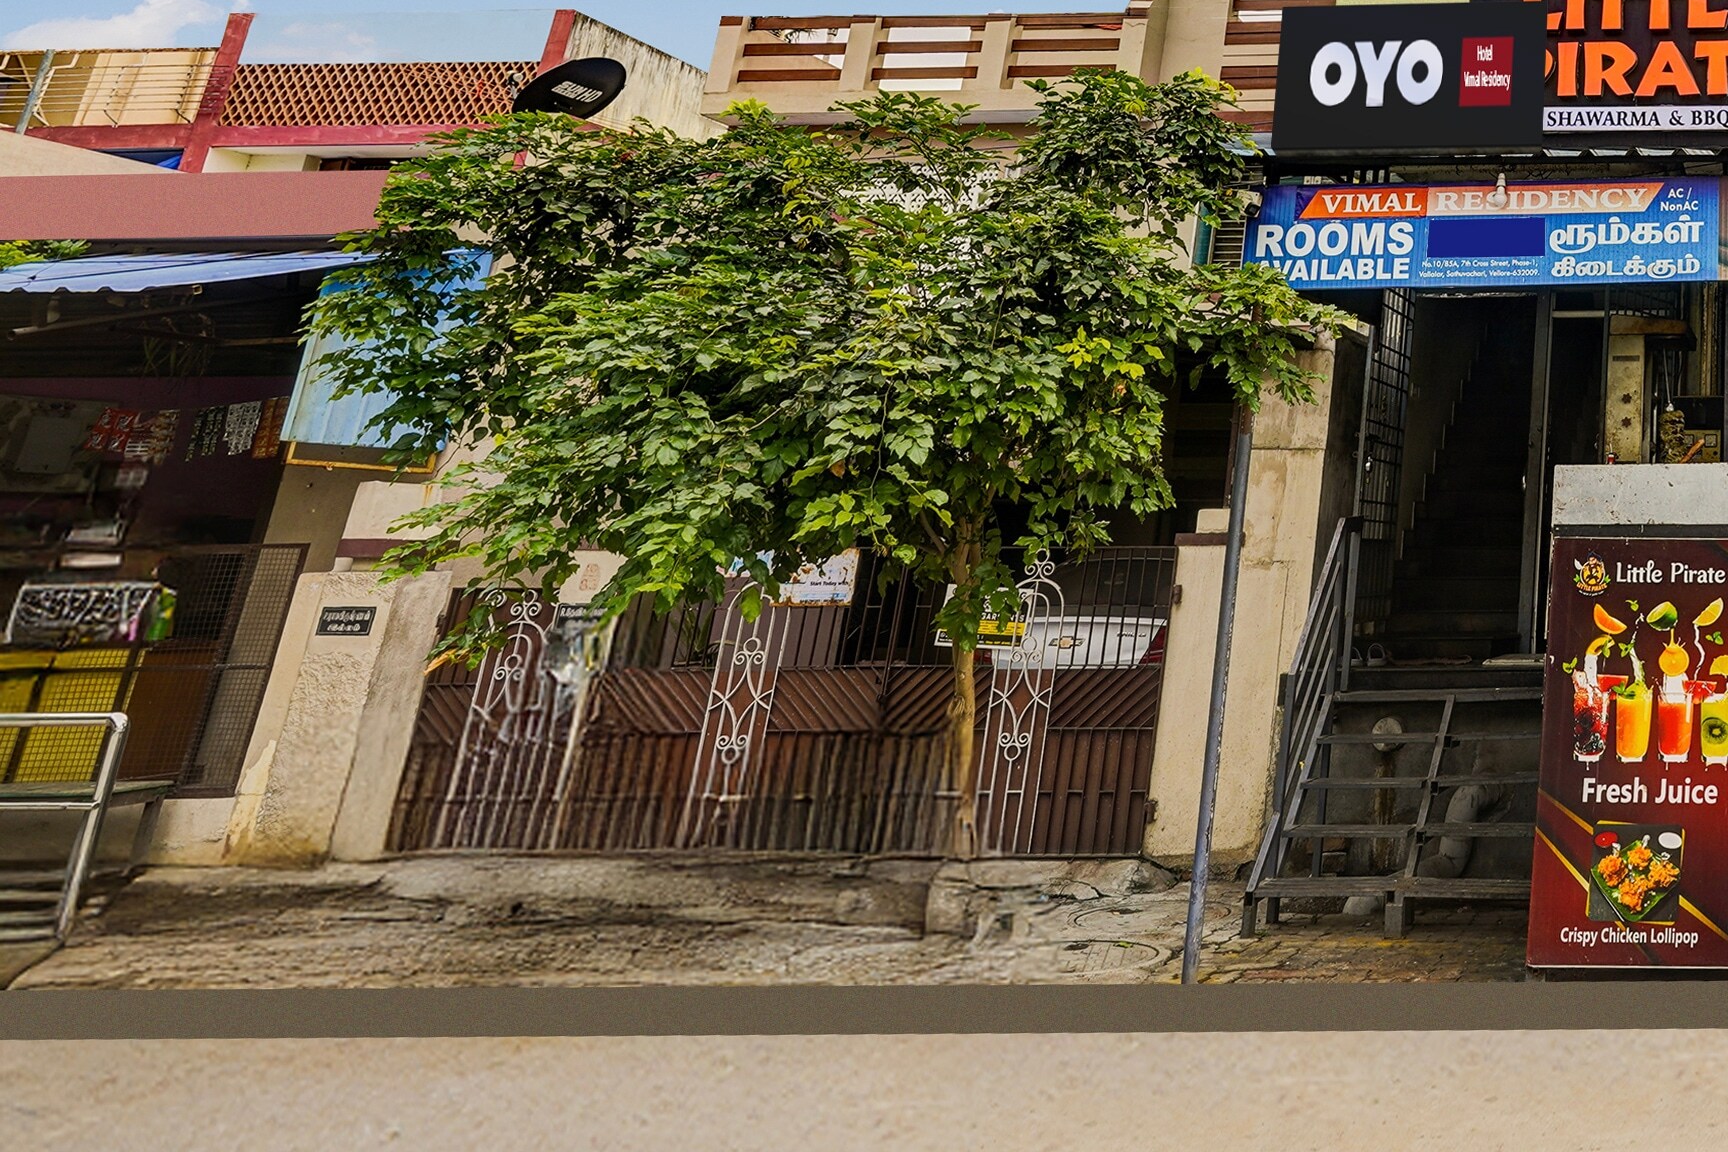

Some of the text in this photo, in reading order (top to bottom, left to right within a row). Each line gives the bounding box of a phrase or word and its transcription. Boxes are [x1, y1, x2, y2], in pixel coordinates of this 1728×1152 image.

[1476, 44, 1494, 62] Hotel
[1310, 39, 1443, 107] OYO
[1464, 70, 1511, 91] Vimal Residency
[562, 81, 588, 97] SUN
[576, 89, 604, 103] HD
[1547, 110, 1661, 127] SHAWARMA
[1669, 110, 1685, 126] &
[1322, 188, 1648, 214] VIMAL RESIDENCY
[1667, 188, 1684, 199] AC
[1660, 201, 1699, 211] NonAC
[1255, 222, 1414, 258] ROOMS
[1550, 214, 1705, 254] ரூம்கள்
[1419, 270, 1445, 279] Vallalar,
[1489, 269, 1540, 277] Vellore-632009.
[1490, 259, 1510, 268] Street,
[1511, 259, 1538, 267] Phase-1,
[1551, 253, 1700, 279] கிடைக்கும்
[1616, 560, 1726, 584] Little Pirate
[1582, 777, 1718, 805] Fresh Juice
[1560, 927, 1698, 948] Crispy Chicken Lollipop
